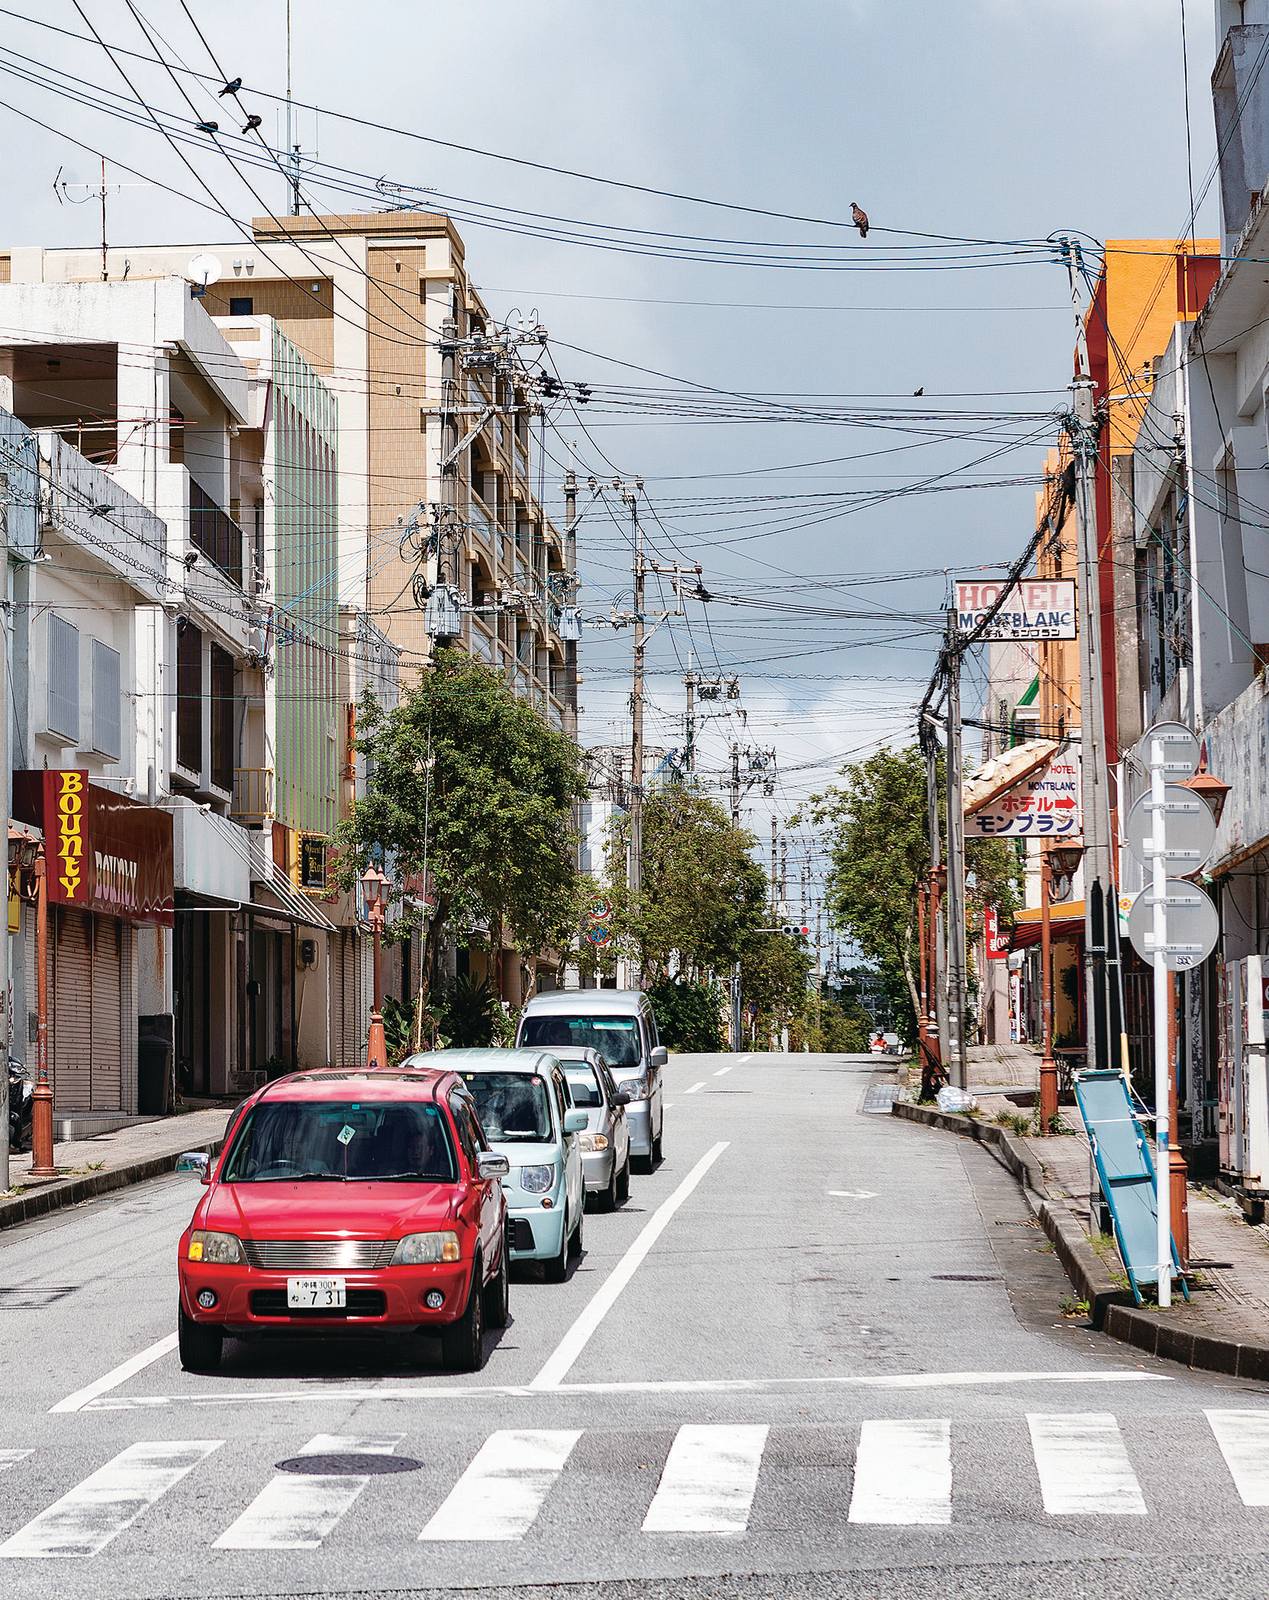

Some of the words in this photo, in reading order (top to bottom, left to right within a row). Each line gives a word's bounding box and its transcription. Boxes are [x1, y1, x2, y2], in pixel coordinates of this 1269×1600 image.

[1051, 765, 1076, 774] HOTEL
[1027, 782, 1076, 790] MONTBLANC
[1001, 795, 1054, 813] ホテル
[976, 814, 1074, 832] モンブラン
